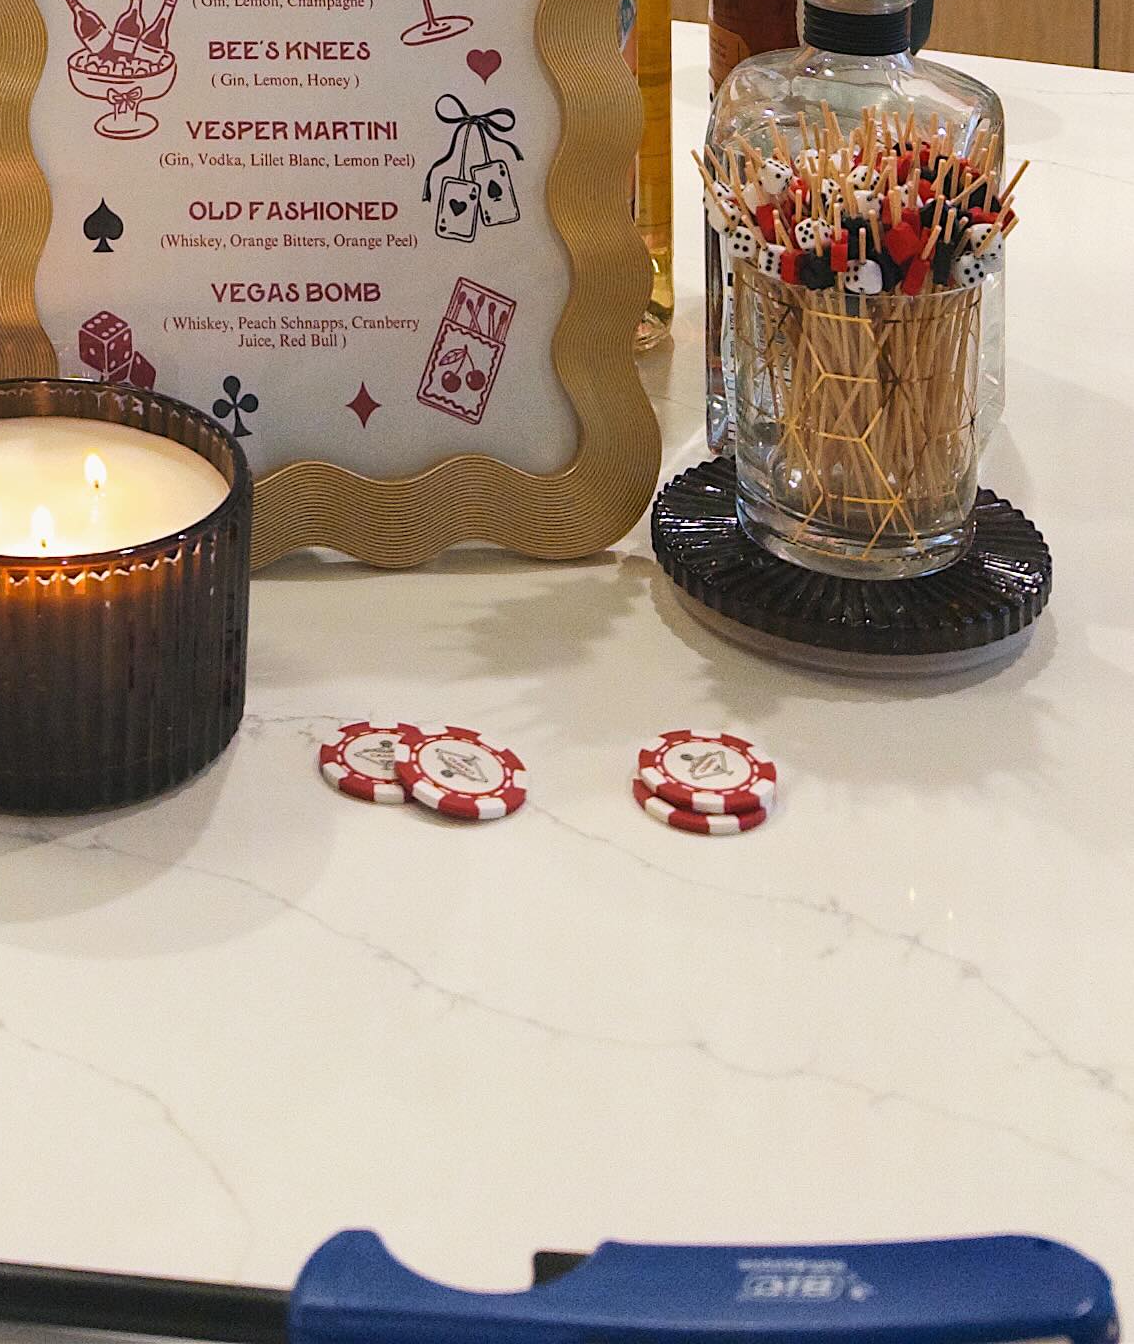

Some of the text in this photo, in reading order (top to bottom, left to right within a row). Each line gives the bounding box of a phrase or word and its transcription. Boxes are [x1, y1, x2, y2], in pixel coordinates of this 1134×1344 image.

[209, 41, 370, 60] BEE'S KNEES
[221, 74, 248, 87] Gin,
[254, 74, 302, 87] Lemon,
[308, 74, 350, 89] Honey
[186, 121, 397, 140] VESPER MARTINI
[160, 153, 415, 169] (Gin, Vodka, Lillet Blanc, Lemon Peel)
[189, 201, 398, 220] OLD FASHIONED
[161, 234, 417, 250] (Whiskey, Orange Bitters, Orange Peel)
[211, 283, 380, 302] VEGAS BOMB
[173, 317, 233, 332] Whiskey,
[239, 317, 276, 329] Peach
[281, 316, 347, 333] Schnapps,
[352, 316, 419, 332] Cranberry
[238, 334, 275, 349] Juice,
[280, 334, 306, 347] Red
[311, 334, 337, 347] Bull
